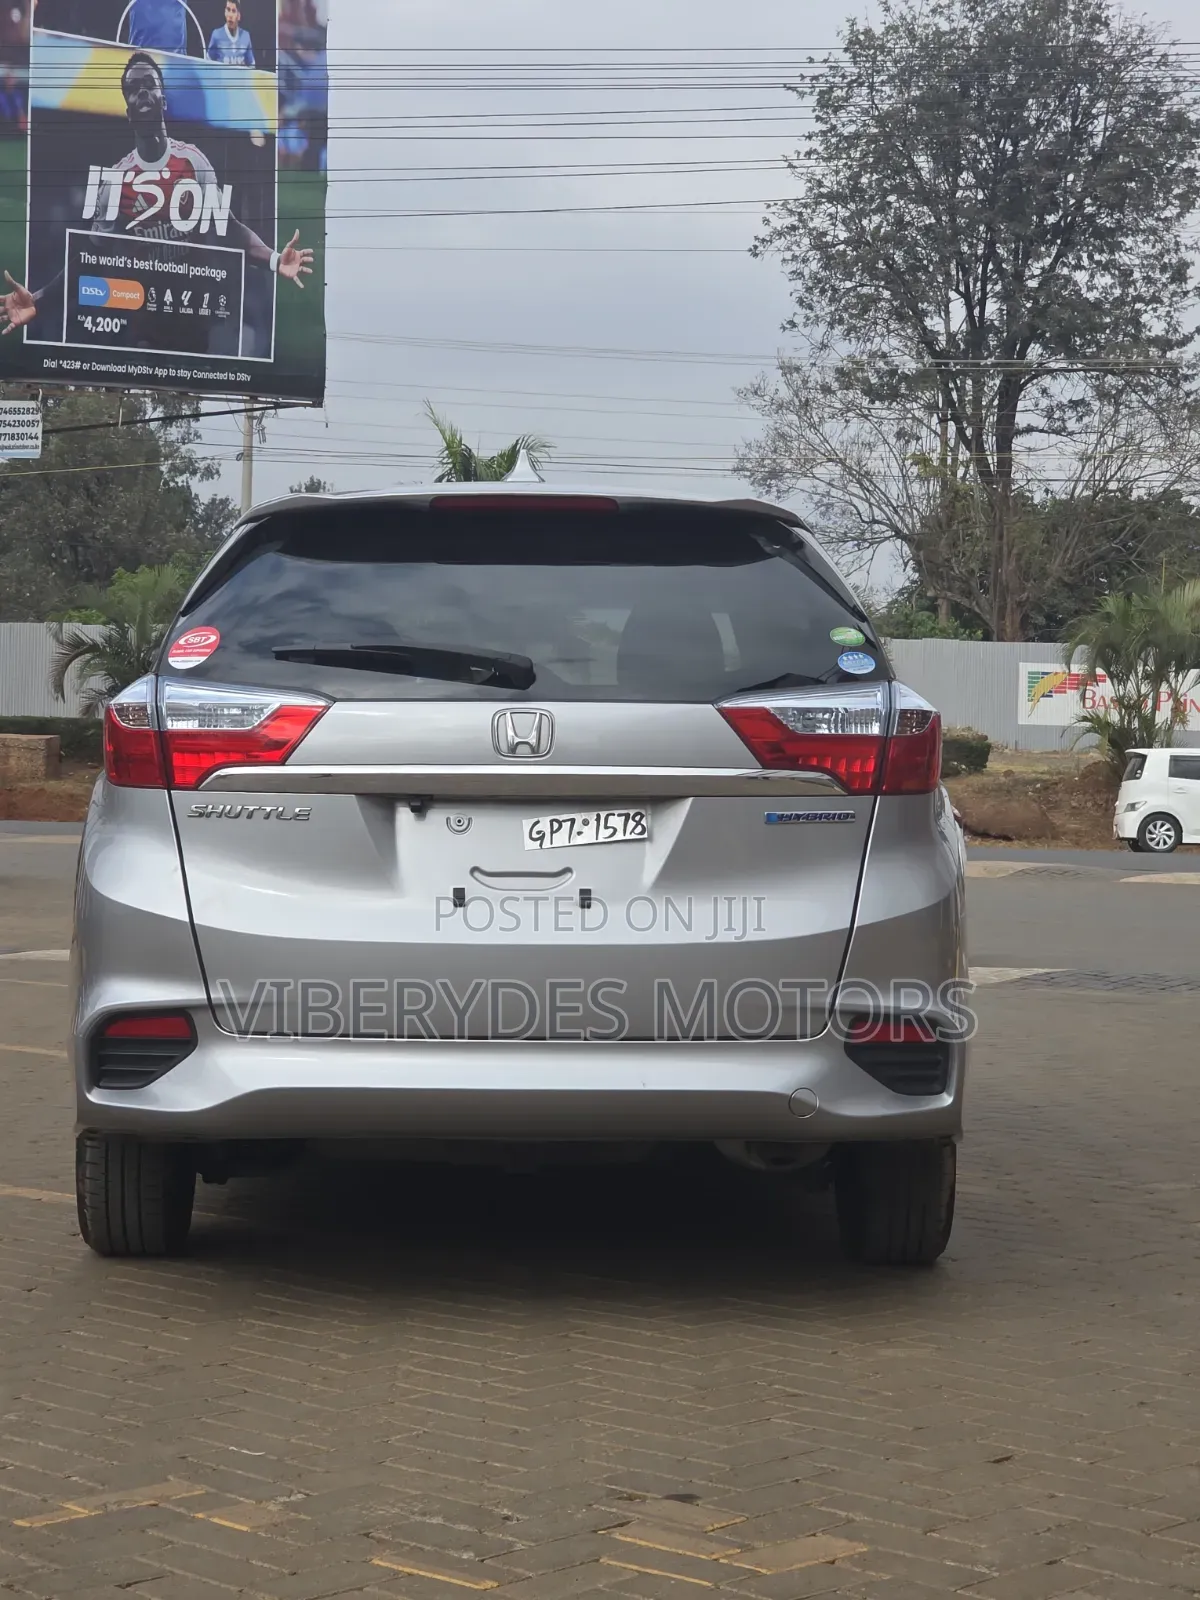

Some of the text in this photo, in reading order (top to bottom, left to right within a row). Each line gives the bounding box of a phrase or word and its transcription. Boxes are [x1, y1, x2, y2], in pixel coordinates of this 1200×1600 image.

[169, 178, 232, 236] ON
[80, 252, 227, 281] The world's best football package
[81, 286, 140, 300] DStv Compact
[84, 316, 121, 333] 4,200
[43, 358, 58, 368] Dial
[82, 362, 90, 371] or
[91, 362, 127, 373] Download
[127, 364, 153, 376] MyDStv
[154, 367, 168, 378] App
[169, 368, 176, 376] to
[177, 368, 191, 379] stay
[192, 370, 228, 380] Connected
[228, 372, 236, 381] to
[236, 373, 252, 382] DStv
[187, 636, 208, 644] SBT
[187, 804, 312, 821] SHUTTLE
[778, 812, 851, 822] HYBRID
